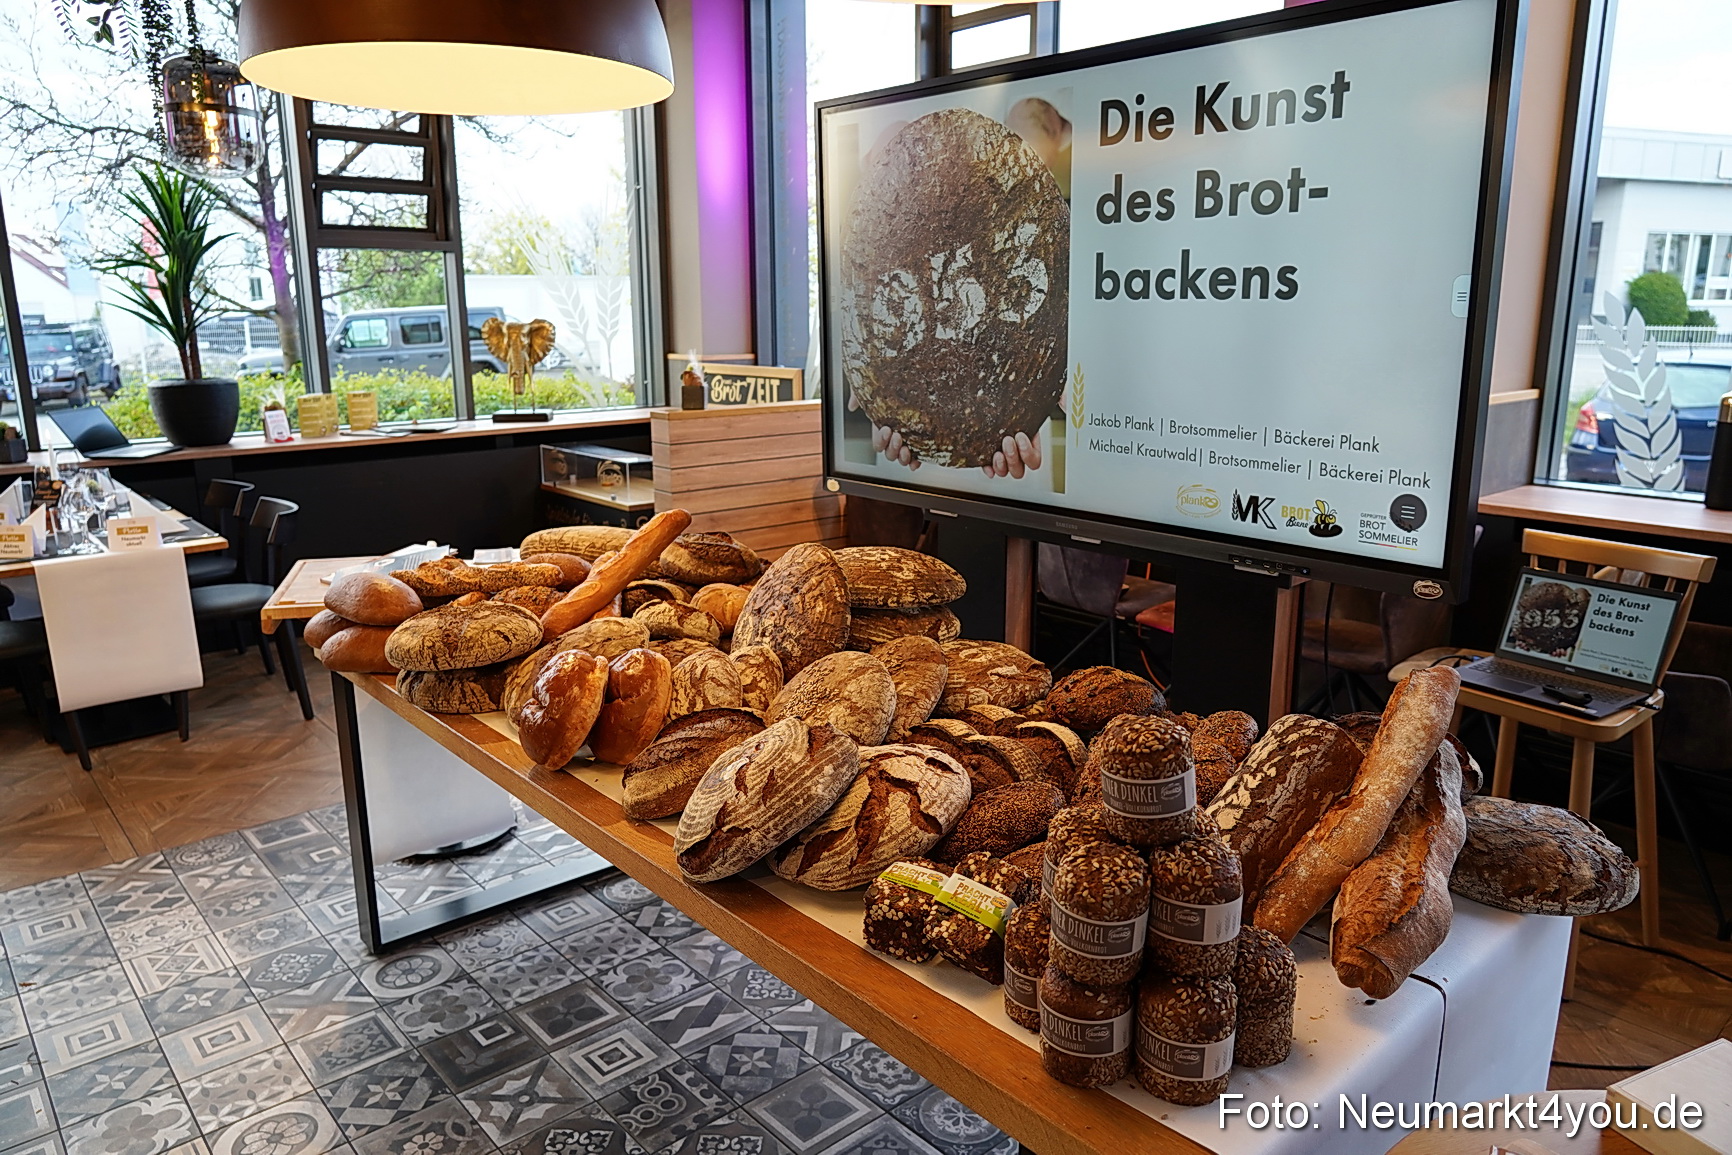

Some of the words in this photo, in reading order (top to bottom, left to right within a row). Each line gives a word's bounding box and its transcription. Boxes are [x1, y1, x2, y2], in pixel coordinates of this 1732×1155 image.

[1099, 93, 1175, 147] Die
[1194, 70, 1351, 136] Kunst
[1096, 173, 1176, 225] des
[1194, 167, 1329, 219] Brot-
[1094, 248, 1299, 301] backens
[1088, 413, 1122, 428] Jakob
[1124, 415, 1155, 432] Plank
[1169, 420, 1257, 441] Brotsommelier
[1274, 429, 1335, 449] Bäckerei
[1339, 434, 1380, 453] Plank
[1089, 438, 1133, 455] Michael
[1136, 443, 1197, 462] Krautwald
[1208, 450, 1302, 474] Brotsommelier
[1319, 462, 1383, 484] Bäckerei
[1388, 468, 1431, 489] Plank
[1281, 505, 1311, 520] BROT
[1359, 519, 1387, 531] BROT
[1358, 530, 1418, 546] SOMMELIER
[1597, 593, 1616, 605] Die
[1618, 597, 1651, 611] Kunst
[1592, 606, 1612, 619] des
[1615, 610, 1643, 624] Brot-
[1588, 619, 1635, 637] backens
[1120, 783, 1159, 803] DINKEL
[891, 864, 928, 877] PRACHT
[956, 882, 992, 903] PRACHT
[1067, 917, 1105, 944] DINKEL
[1049, 1014, 1082, 1042] DINKEL
[1140, 1028, 1171, 1062] DINKEL
